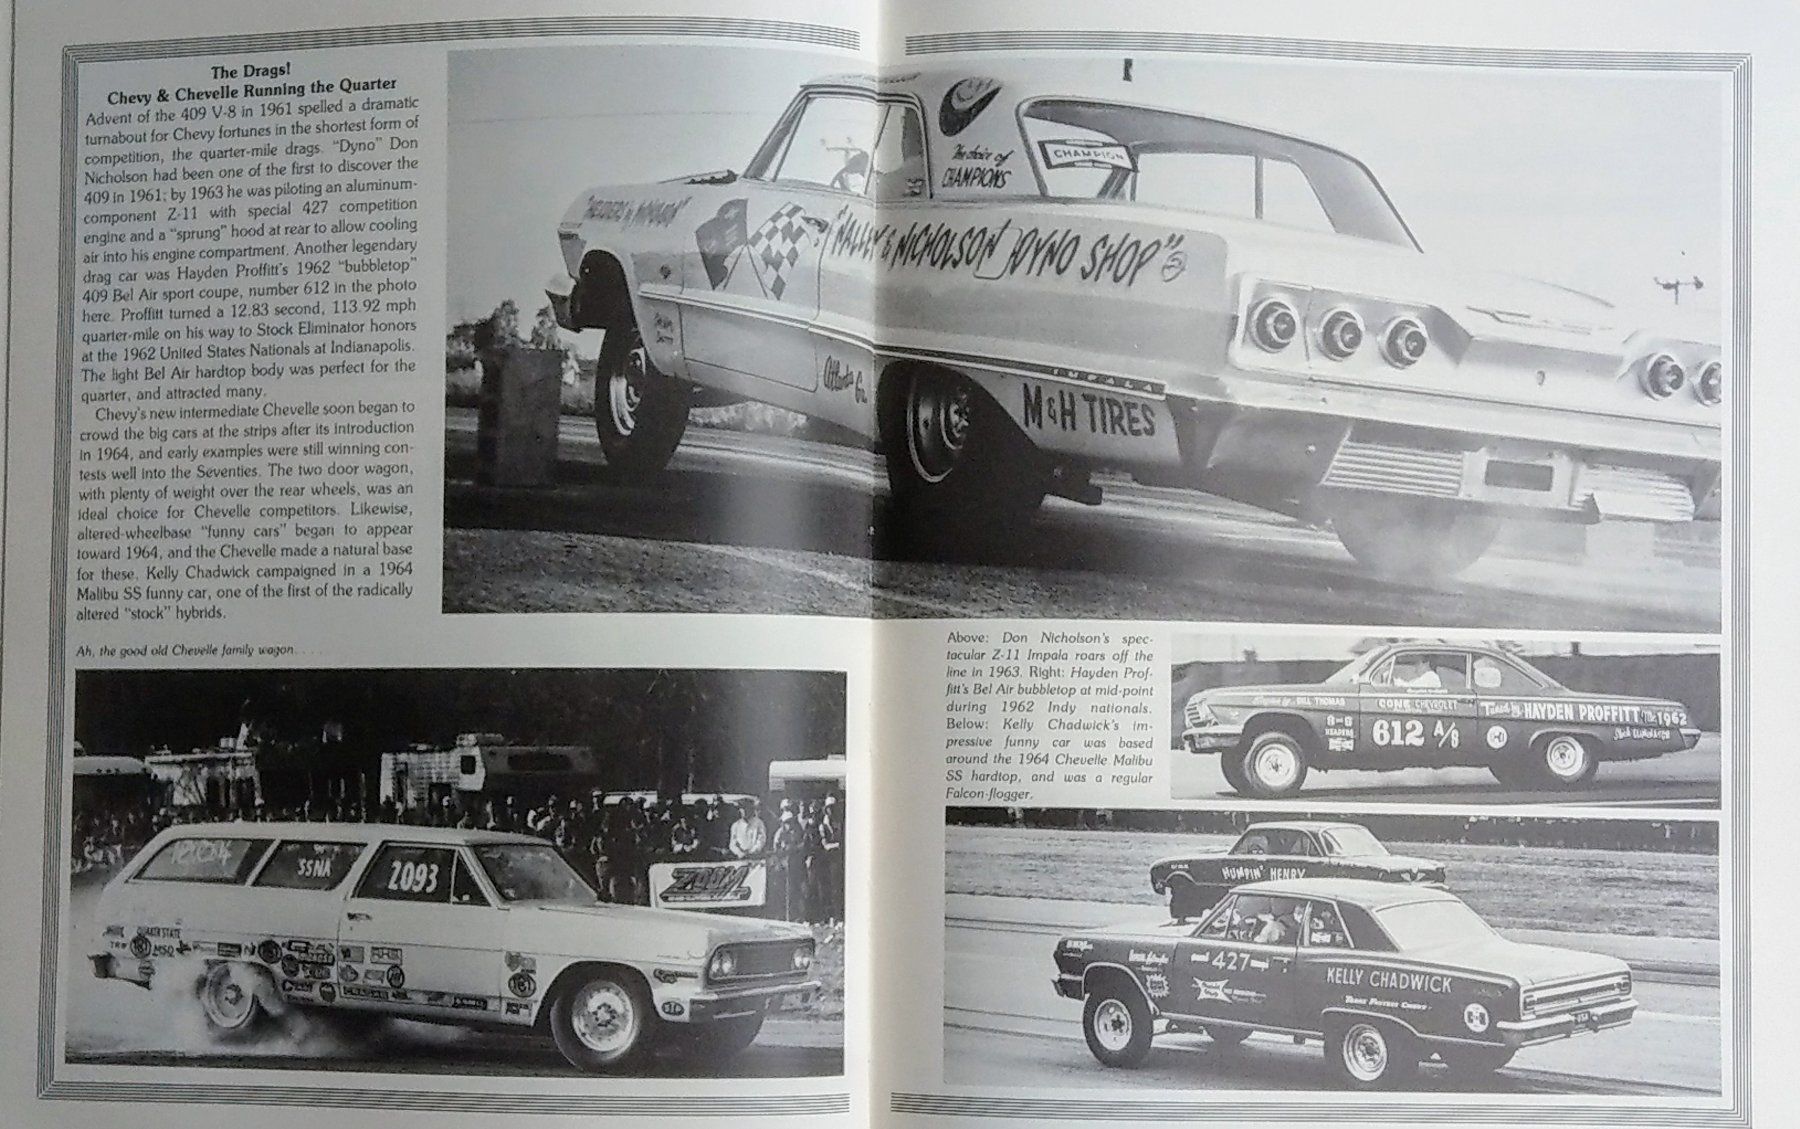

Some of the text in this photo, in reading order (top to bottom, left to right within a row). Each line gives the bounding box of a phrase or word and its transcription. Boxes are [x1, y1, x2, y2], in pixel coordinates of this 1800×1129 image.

[211, 62, 290, 79] The Drags!
[108, 78, 396, 106] Chevy & Chevelle Running the Quarter
[86, 96, 418, 126] Advent of the 409 V-8 in 1961 spelled a dramatic
[1053, 149, 1125, 161] CHAMPION
[941, 167, 1013, 190] CHAMPIONS
[84, 199, 416, 226] component Z-11 with special 427 competition
[888, 218, 1013, 272] NICHOLSON
[1009, 226, 1081, 276] DYNO
[83, 270, 111, 286] drag
[119, 272, 137, 282] car
[146, 271, 170, 280] was
[178, 265, 228, 282] Hayden
[298, 260, 330, 275] 1962
[82, 338, 414, 362] at the 1962 United States Nationals at Indianapolis.
[1053, 368, 1153, 392] IMPALA
[82, 384, 266, 404] quarter, and attracted many.
[1081, 392, 1156, 437] TIRES
[76, 606, 118, 621] altered
[176, 605, 226, 622] hybrids.
[948, 631, 1153, 646] Above: Don Nicholson's spec-
[76, 646, 94, 657] Ah,
[100, 645, 116, 657] the
[120, 645, 147, 659] good
[151, 645, 168, 656] old
[172, 644, 218, 656] Chevelle
[222, 644, 254, 658] family
[947, 649, 986, 660] tacular
[992, 649, 1019, 660] Z-11
[1028, 649, 1068, 662] Impala
[1112, 650, 1129, 663] off
[1135, 650, 1152, 661] the
[947, 666, 1152, 680] line in 1963. Right: Hayden Prof-
[946, 683, 1152, 698] fitt's Bel Air bubbletop at mid-point
[947, 700, 1152, 715] during 1962 Indy nationals.
[1414, 699, 1459, 710] CHEVROLET
[1523, 703, 1574, 721] HAYDEN
[1578, 704, 1641, 723] PROFFITT
[1657, 710, 1688, 727] 1962
[947, 718, 1152, 732] Below: Kelly Chadwick's im-
[1372, 718, 1425, 747] 612
[946, 737, 992, 749] pressive
[1004, 735, 1039, 749] funny
[1084, 740, 1106, 748] was
[1119, 737, 1152, 748] based
[946, 753, 1152, 766] around the 1964 Chevelle Malibu
[946, 770, 962, 781] SS
[971, 770, 1021, 784] hardtop,
[1032, 771, 1054, 782] and
[1112, 772, 1152, 785] regular
[946, 787, 1032, 802] Falcon-flogger.
[297, 855, 332, 878] SSNA
[1221, 865, 1306, 881] HUMPIN' HENRY
[388, 859, 438, 894] 2093
[1212, 952, 1251, 972] 427
[1326, 967, 1363, 986] KELLY
[1369, 971, 1453, 994] CHADWICK
